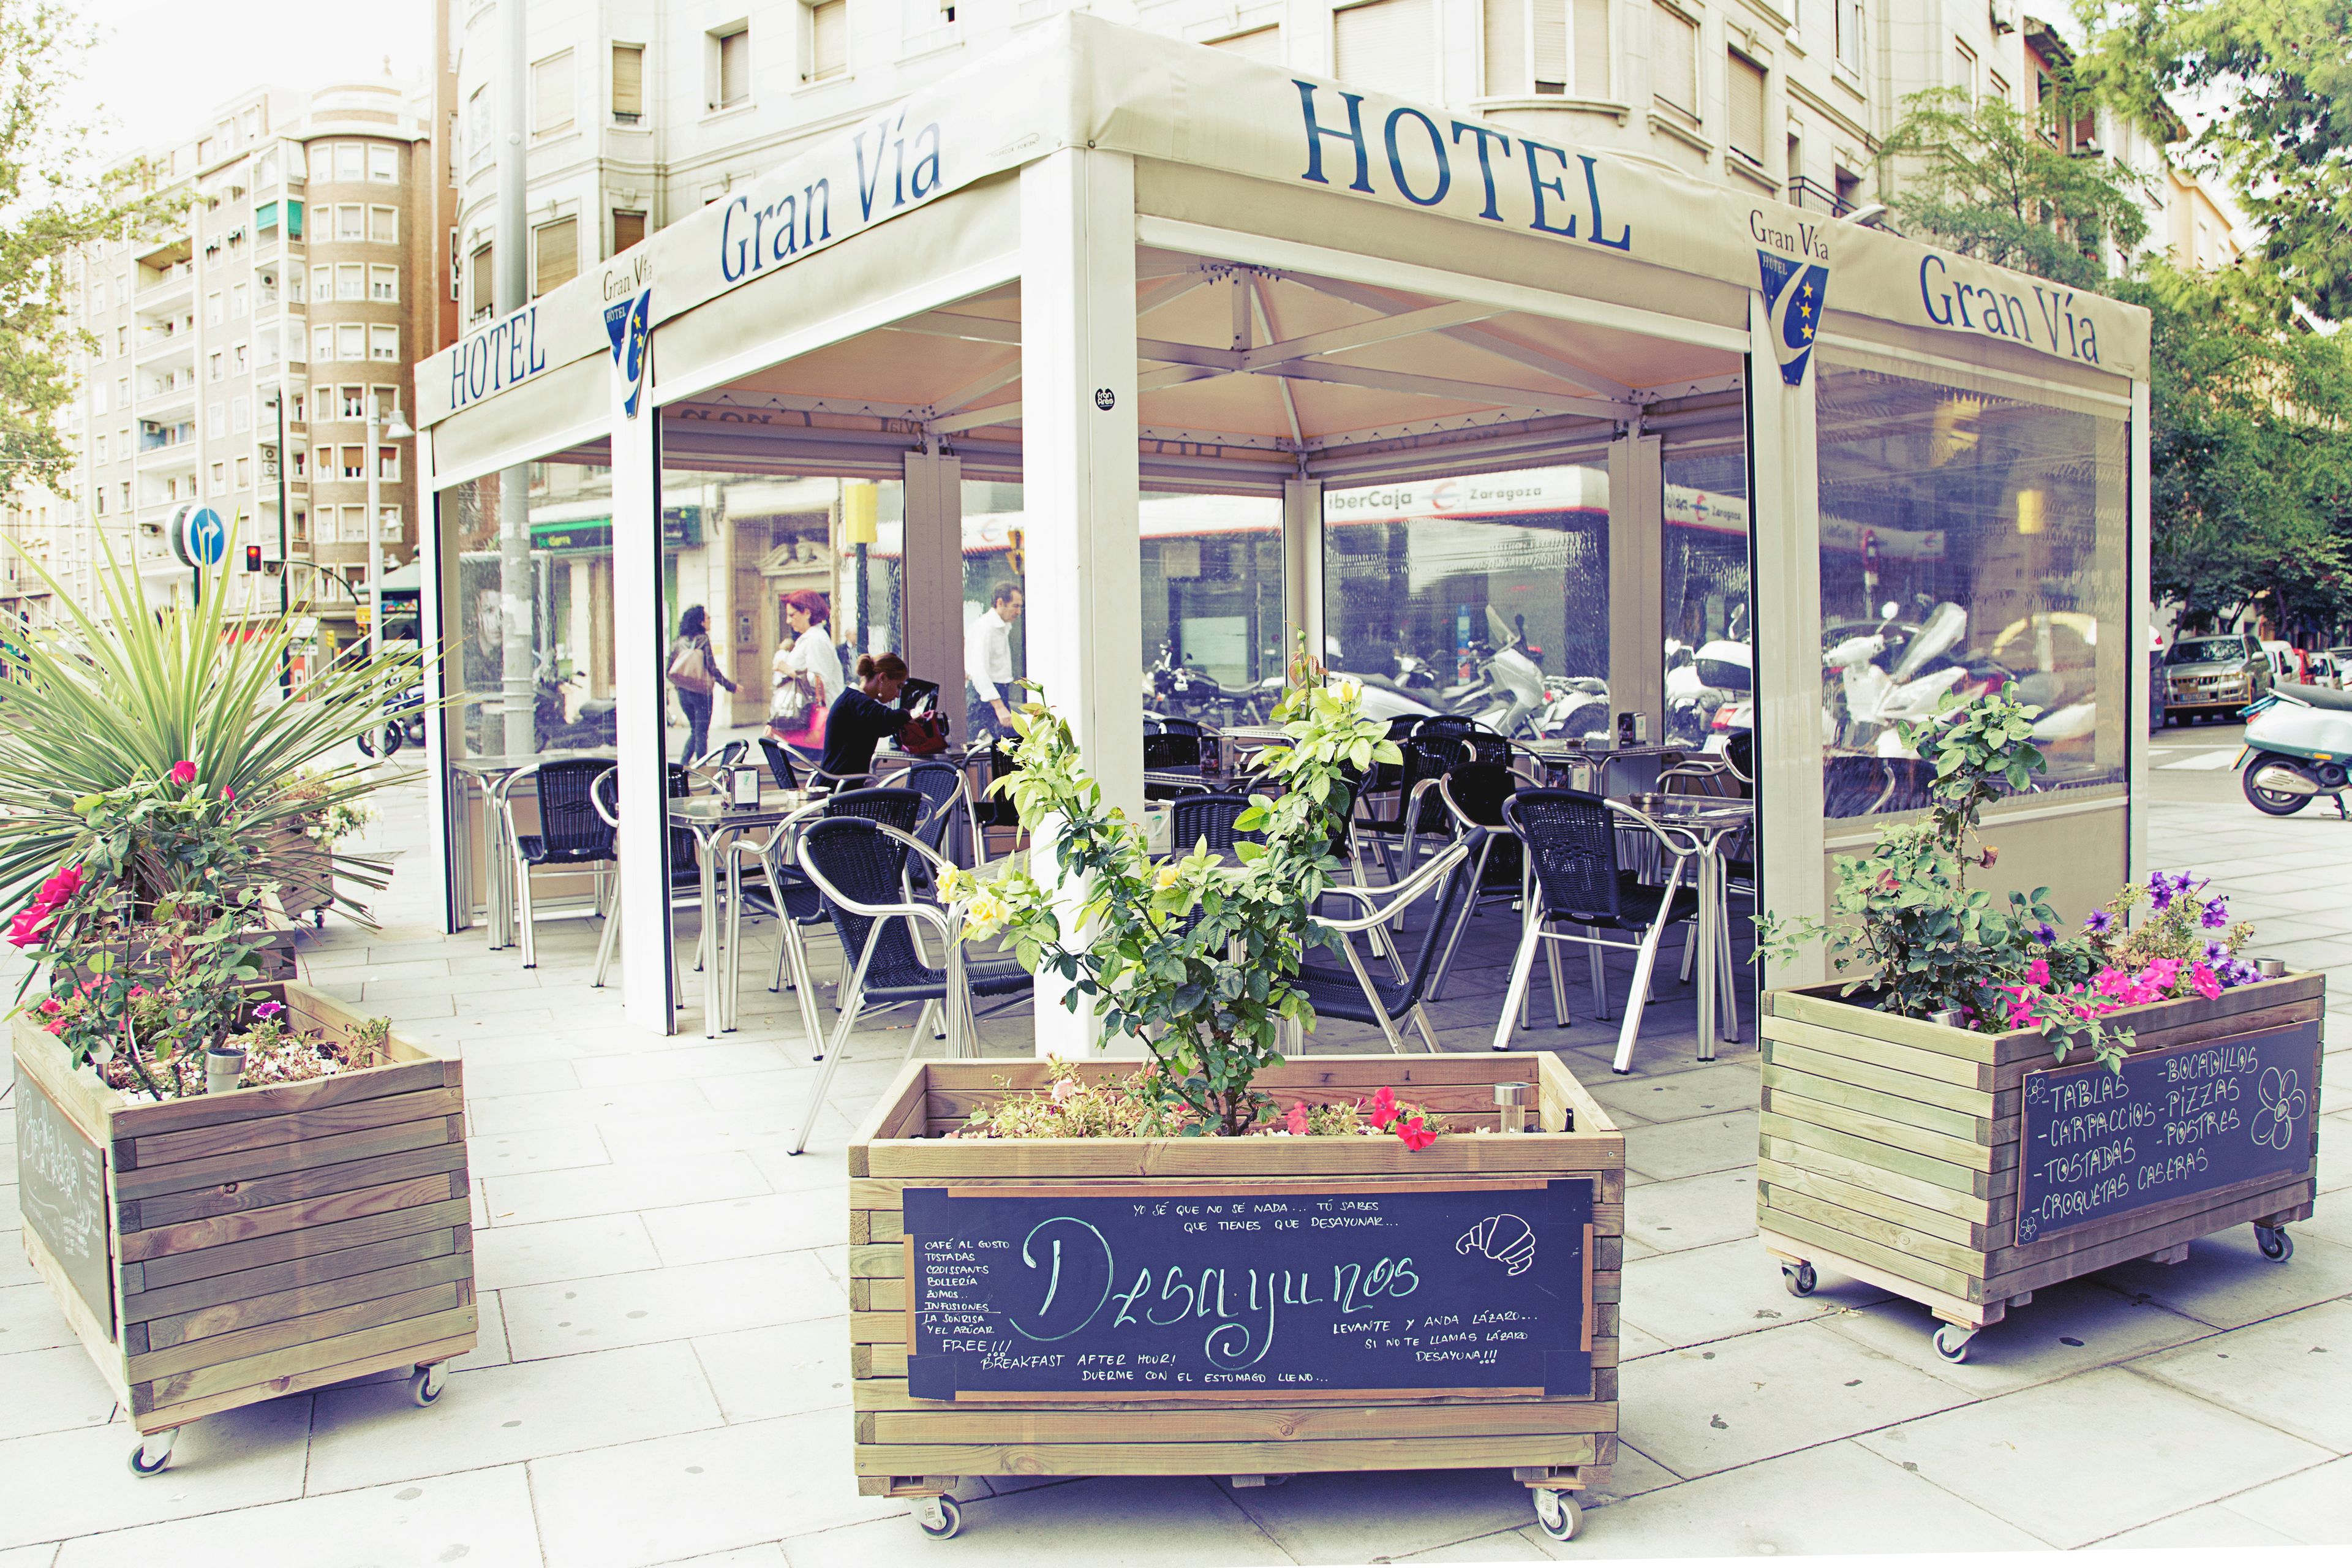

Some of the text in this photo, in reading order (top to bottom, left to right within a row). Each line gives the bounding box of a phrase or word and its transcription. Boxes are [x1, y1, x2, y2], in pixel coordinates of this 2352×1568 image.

[1291, 79, 1630, 251] HOTEL
[722, 103, 943, 282] Gran Vía
[1750, 209, 1829, 260] Gran Vía
[1762, 255, 1788, 276] HOTEL
[603, 254, 652, 301] Gran Vía
[606, 306, 626, 324] HOTEL
[1920, 254, 2100, 364] Gran Vía
[450, 305, 546, 410] HOTEL
[1470, 487, 1542, 502] Zaragoza
[2138, 1147, 2209, 1190] CASERAS
[1133, 1204, 1147, 1216] YO
[1152, 1201, 1170, 1215] SÉ
[1176, 1204, 1199, 1216] QUE
[1207, 1204, 1223, 1214] NO
[1232, 1202, 1246, 1213] SÉ
[1340, 1201, 1379, 1211] SABES
[1184, 1222, 1207, 1234] QUE
[1218, 1221, 1261, 1231] TIENES
[1275, 1219, 1299, 1231] QUE
[925, 1237, 1010, 1250] CAFÉ AL GUSTO
[924, 1253, 975, 1262] TOSTADAS
[925, 1265, 989, 1275] CROISSANTS
[927, 1275, 978, 1287] BOLLERÍA
[1009, 1217, 1419, 1370] Desayunos
[924, 1301, 989, 1312] INFUSIONES
[924, 1313, 938, 1323] LA
[1333, 1320, 1391, 1335] LEVANTE
[1406, 1319, 1415, 1331] Y
[1424, 1315, 1459, 1327] ANDA
[953, 1324, 995, 1334] AZÚCAR
[1365, 1329, 1528, 1350] SI NO TE LLAMAS LÁZARO
[942, 1340, 1012, 1357] FREE!!!
[980, 1354, 1177, 1370] BREAKFAST AFTER HOUR!
[1415, 1349, 1498, 1365] DESAYUNA!!!
[1145, 1371, 1167, 1381] CON
[1177, 1373, 1193, 1382] EL
[1204, 1373, 1267, 1383] ESTOMAGO
